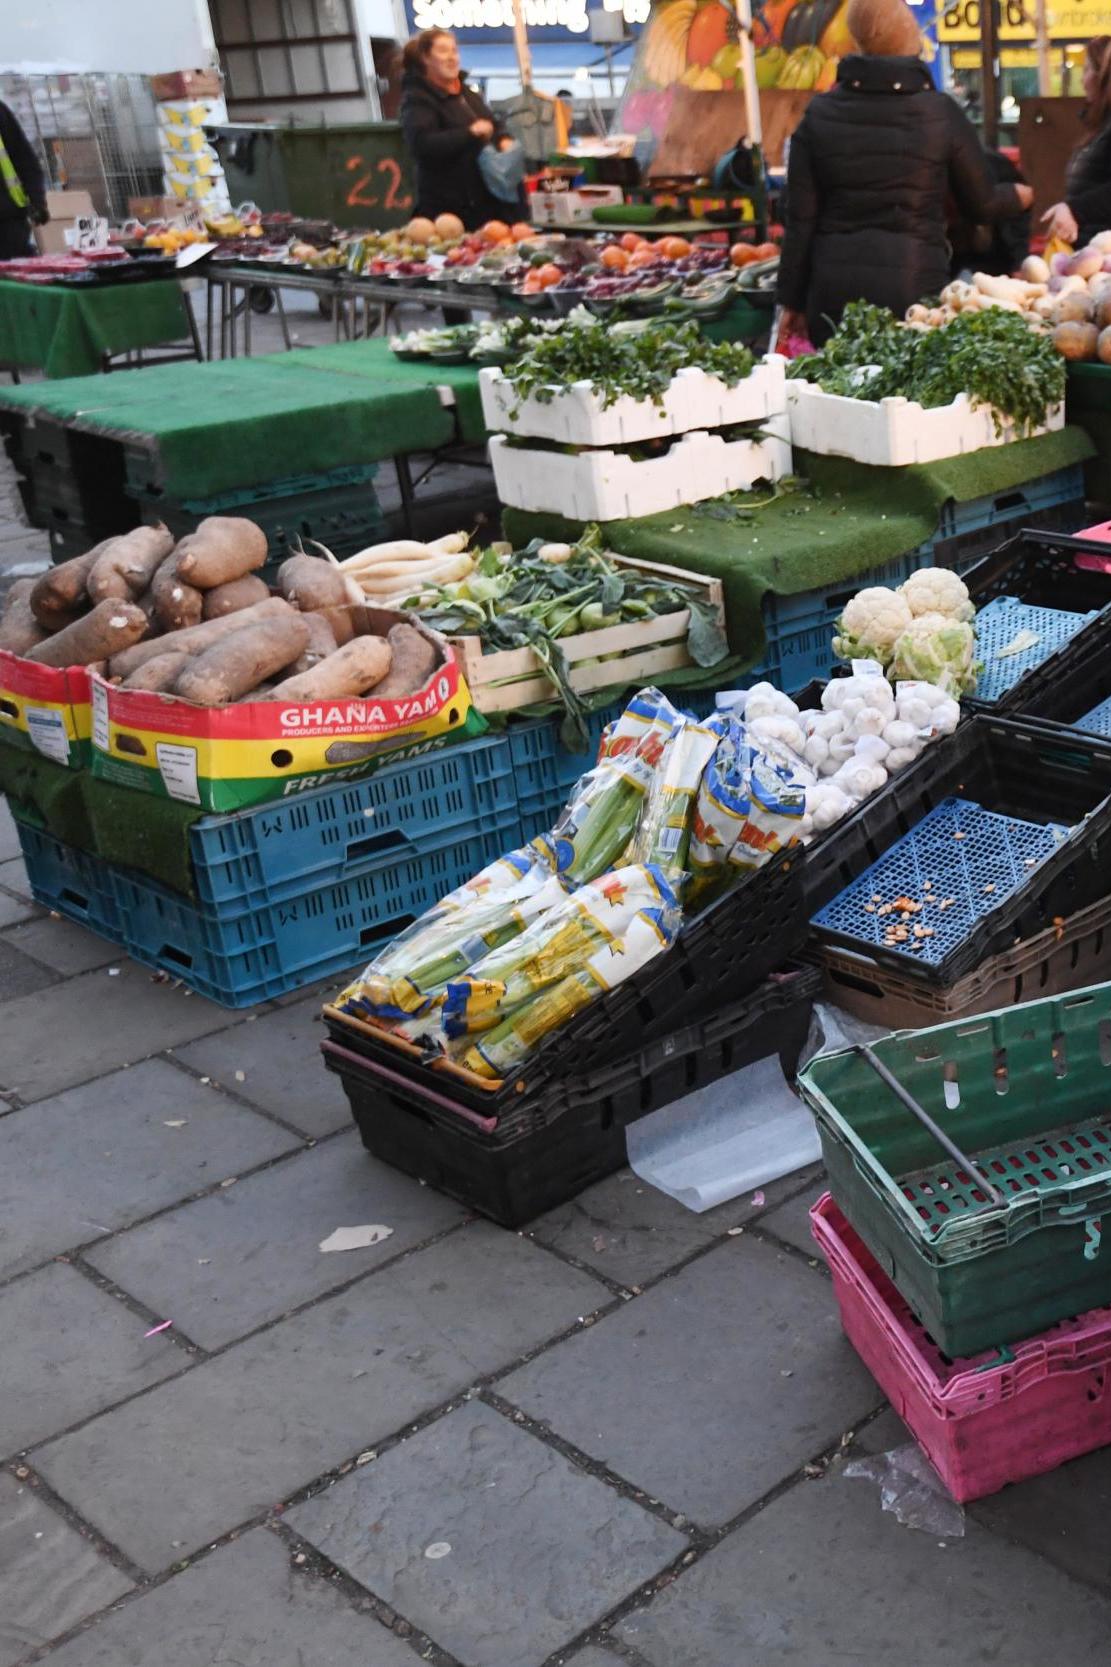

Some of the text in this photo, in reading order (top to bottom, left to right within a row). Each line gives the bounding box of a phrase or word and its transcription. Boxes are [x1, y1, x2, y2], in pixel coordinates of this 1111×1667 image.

[345, 156, 412, 209] 22
[280, 705, 386, 726] GHANA
[393, 690, 437, 719] YAM
[281, 726, 333, 737] PRODUCERS
[334, 725, 352, 734] AND
